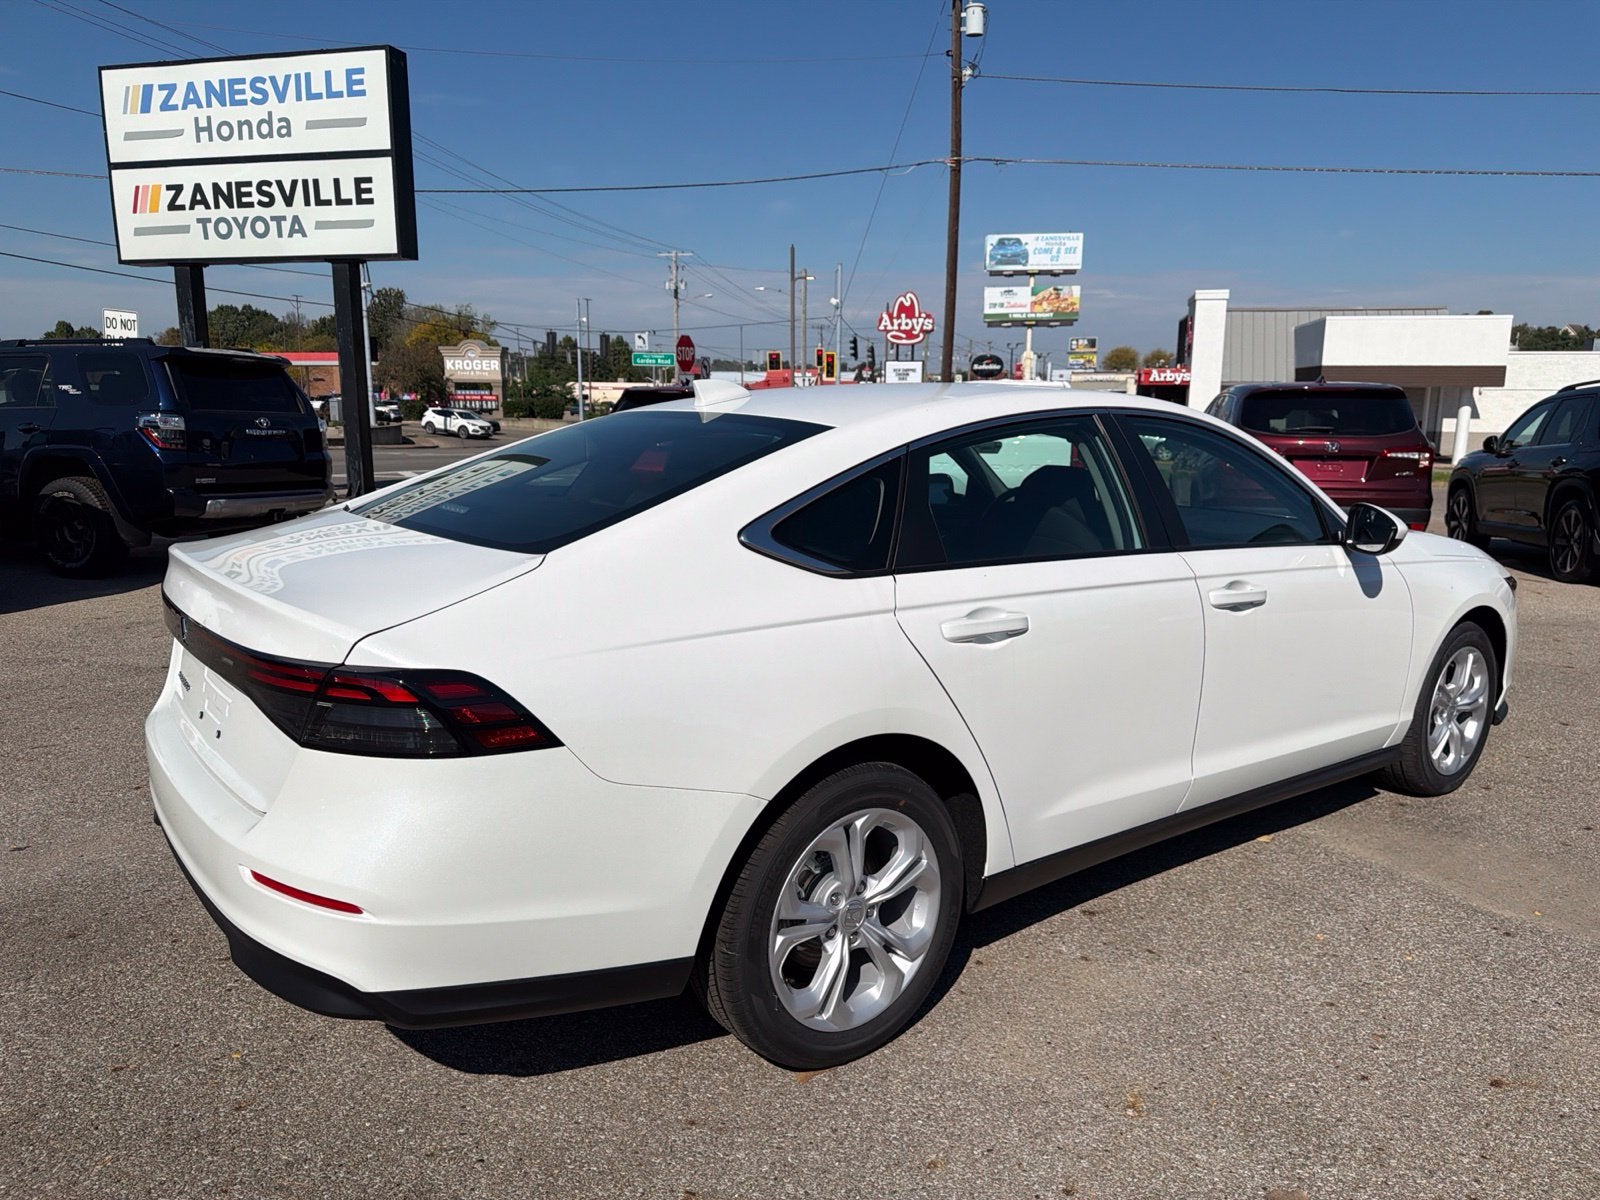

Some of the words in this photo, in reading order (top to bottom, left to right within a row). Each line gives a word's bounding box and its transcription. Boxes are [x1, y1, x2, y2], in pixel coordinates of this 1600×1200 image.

[158, 67, 367, 112] ZANESVILLE
[193, 111, 292, 143] Honda
[165, 176, 375, 212] ZANESVILLE
[196, 214, 308, 241] TOYOTA
[1033, 247, 1054, 255] COME
[105, 316, 118, 330] DO
[120, 318, 137, 331] NOT
[879, 312, 934, 335] Arby's
[677, 346, 695, 361] STOP
[446, 359, 499, 370] KROGER
[1149, 368, 1191, 385] Arby's
